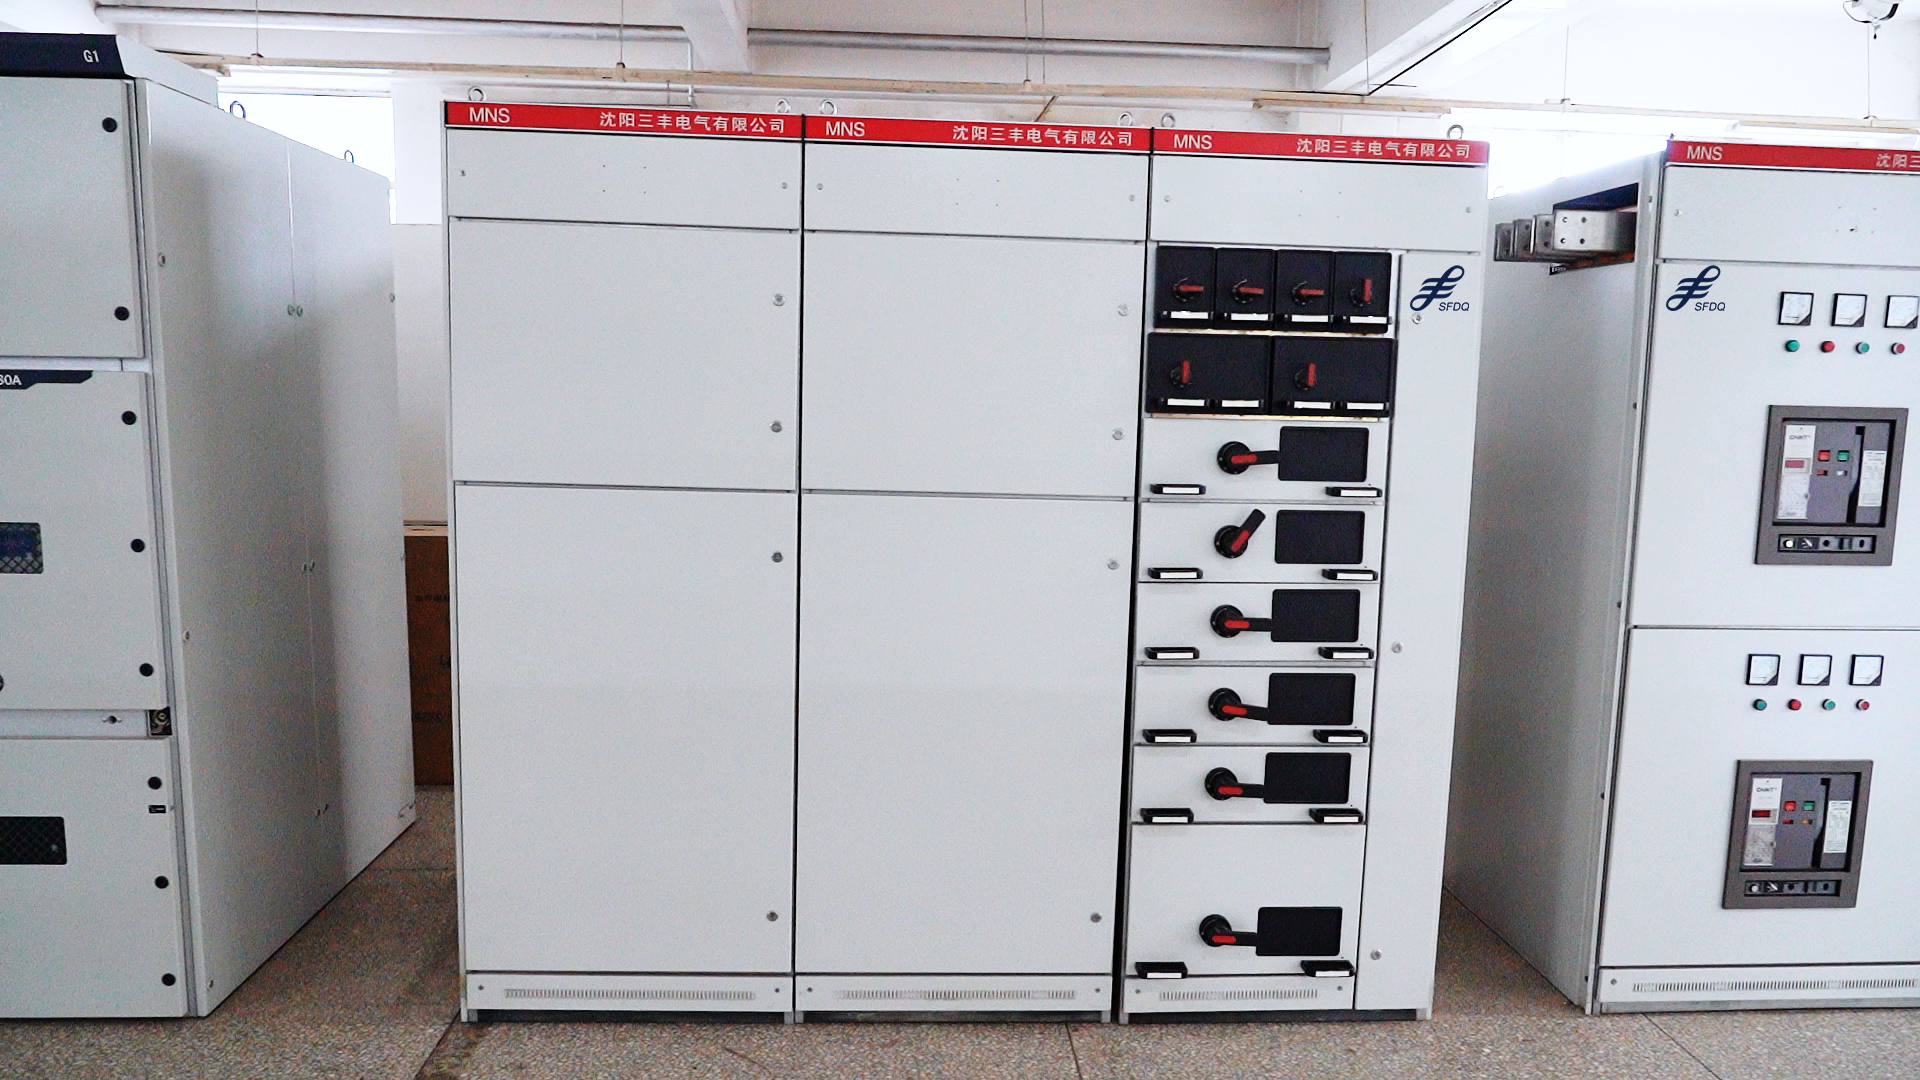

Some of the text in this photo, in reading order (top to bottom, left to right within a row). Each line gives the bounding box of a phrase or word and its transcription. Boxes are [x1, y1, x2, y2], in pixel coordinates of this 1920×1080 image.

[83, 50, 100, 63] G1
[469, 107, 510, 124] MNS
[599, 111, 784, 134] 沈阳三丰电气有限公司
[825, 121, 865, 137] MNS
[952, 125, 1132, 146] 沈阳三丰电气有限公司
[1173, 134, 1212, 149] MNS
[1296, 138, 1470, 158] 沈阳三丰电气有限公司
[1687, 145, 1723, 161] MNS
[1438, 302, 1470, 311] SFDQ
[1694, 302, 1726, 311] SFDQ
